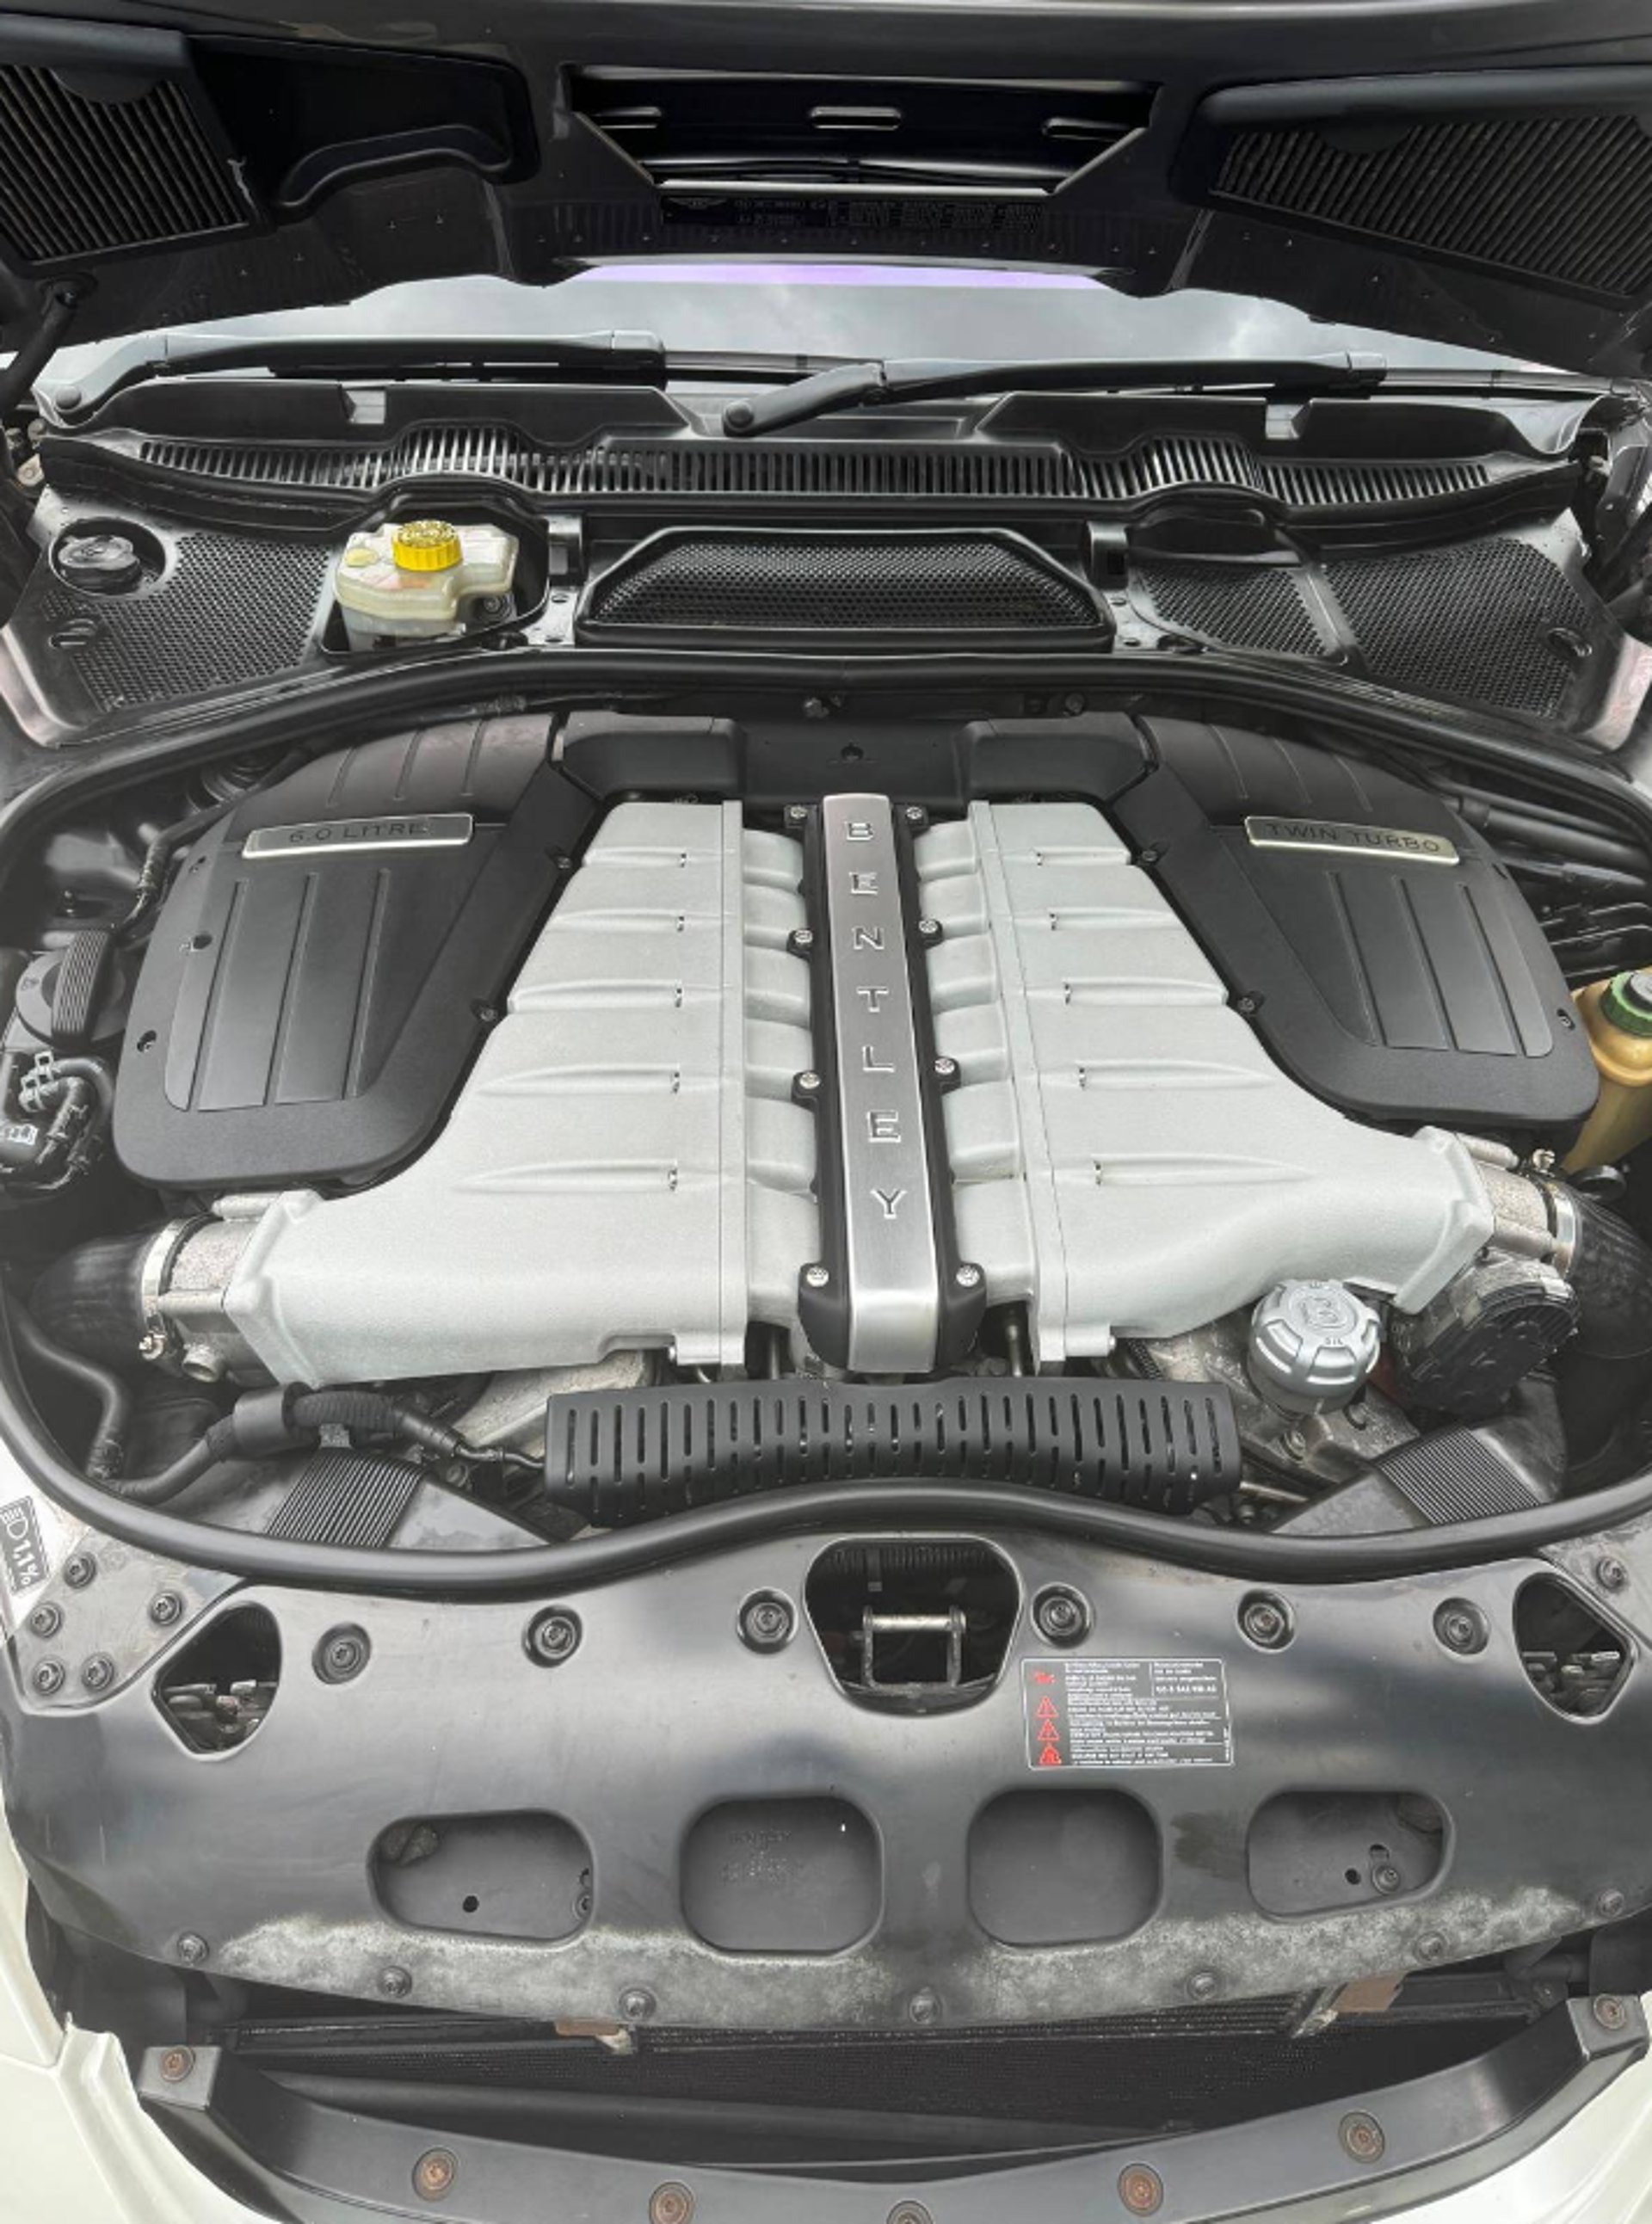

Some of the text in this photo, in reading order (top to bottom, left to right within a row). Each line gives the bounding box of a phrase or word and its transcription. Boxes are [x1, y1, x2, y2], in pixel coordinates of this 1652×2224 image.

[289, 822, 429, 844] 6.0 LITRE
[1267, 822, 1439, 853] TWIN TURBO
[844, 821, 907, 1218] BENTLEY
